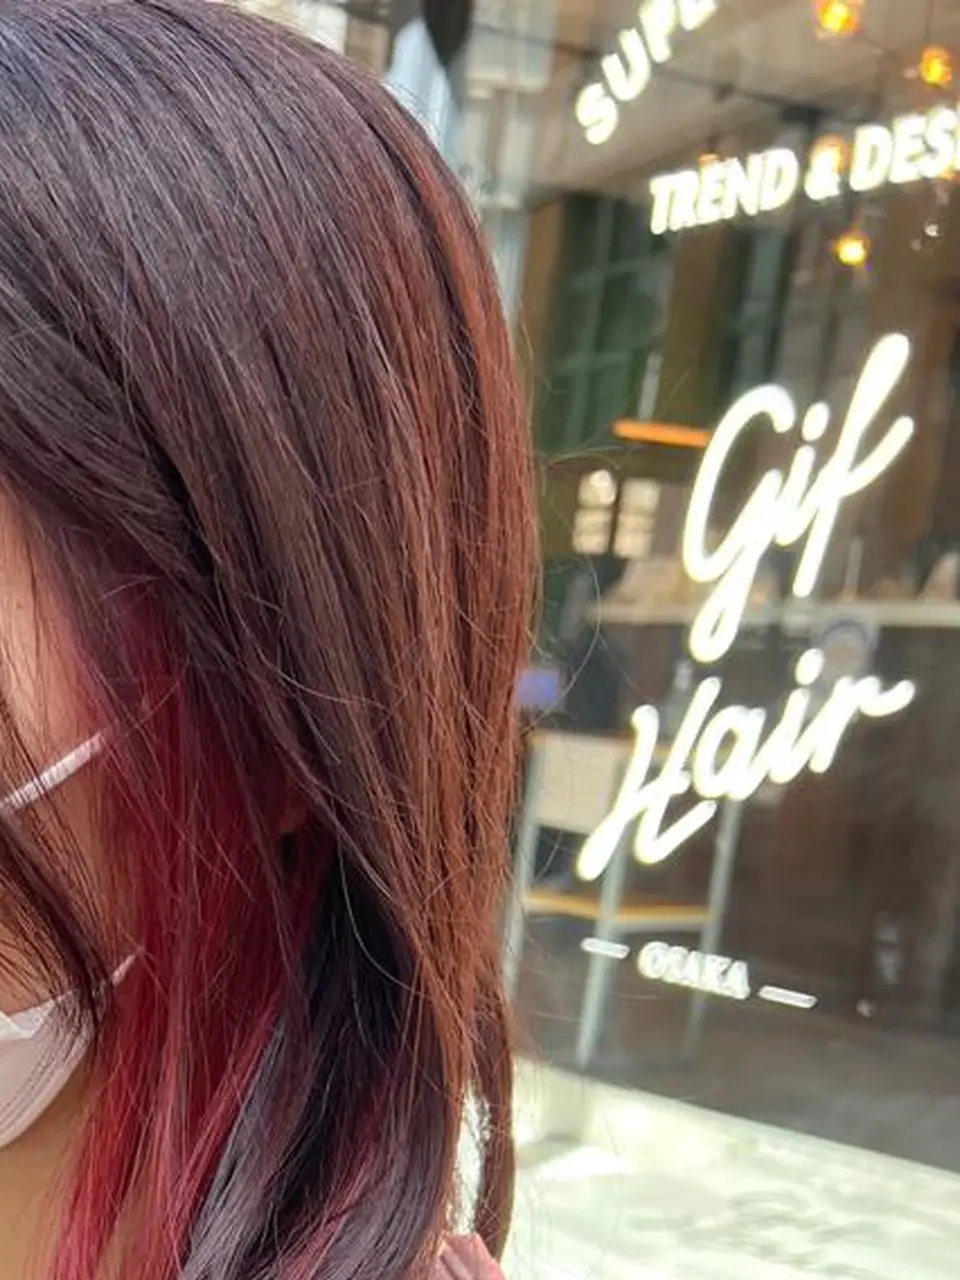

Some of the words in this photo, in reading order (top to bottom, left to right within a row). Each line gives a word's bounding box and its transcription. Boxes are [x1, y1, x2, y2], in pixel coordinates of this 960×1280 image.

[649, 148, 799, 235] TREND
[804, 148, 841, 201] &
[683, 332, 914, 663] Gif
[576, 647, 916, 882] Hair
[638, 941, 751, 1000] OSAKA
